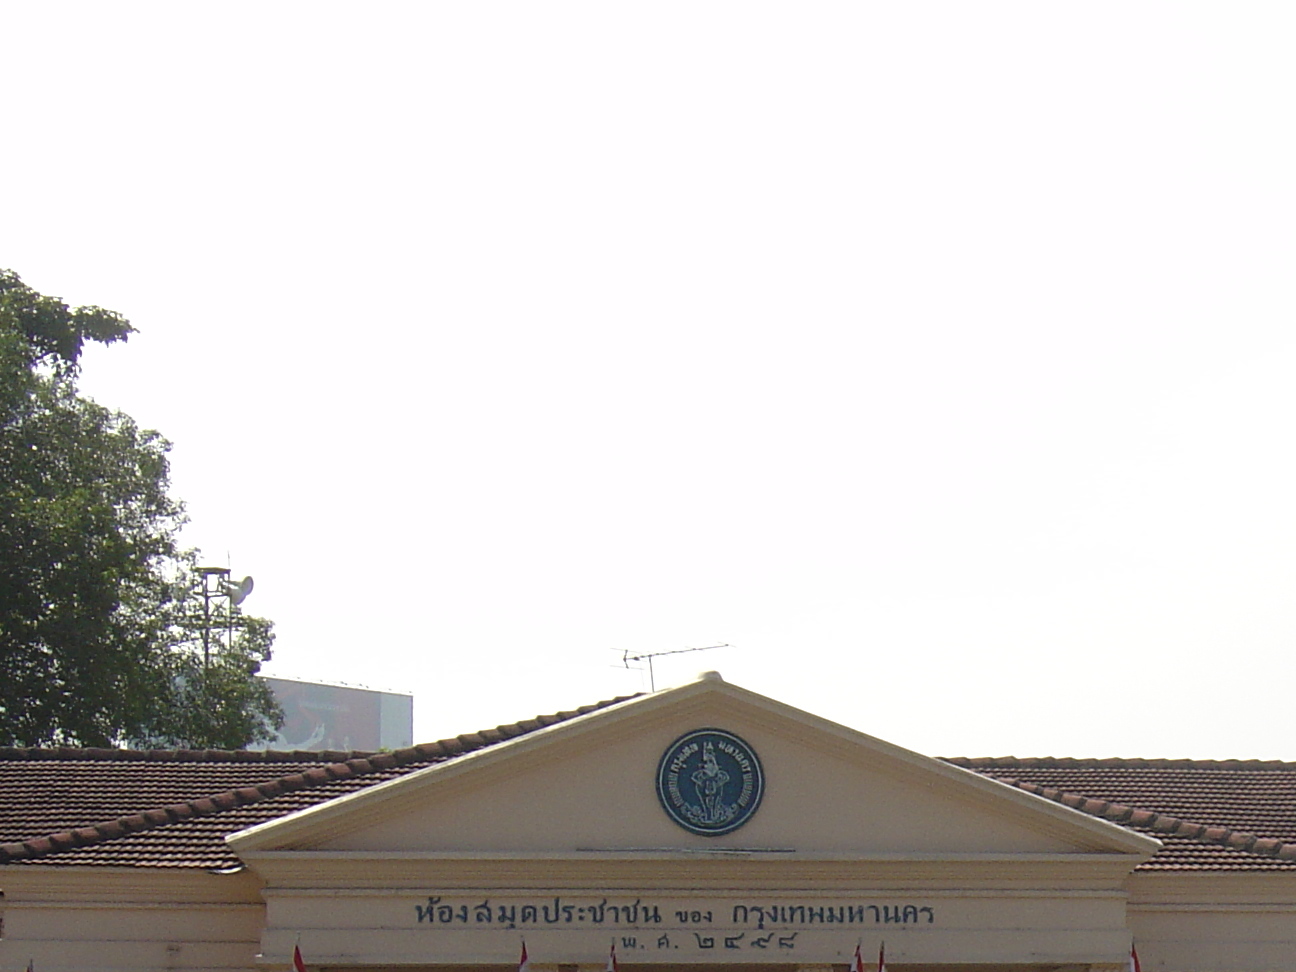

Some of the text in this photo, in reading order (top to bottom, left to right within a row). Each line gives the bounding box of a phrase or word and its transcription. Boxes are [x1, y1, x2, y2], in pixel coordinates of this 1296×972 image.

[415, 896, 935, 929] ห้องสมุดประชาชน ของ กรุงเทพมหานคร
